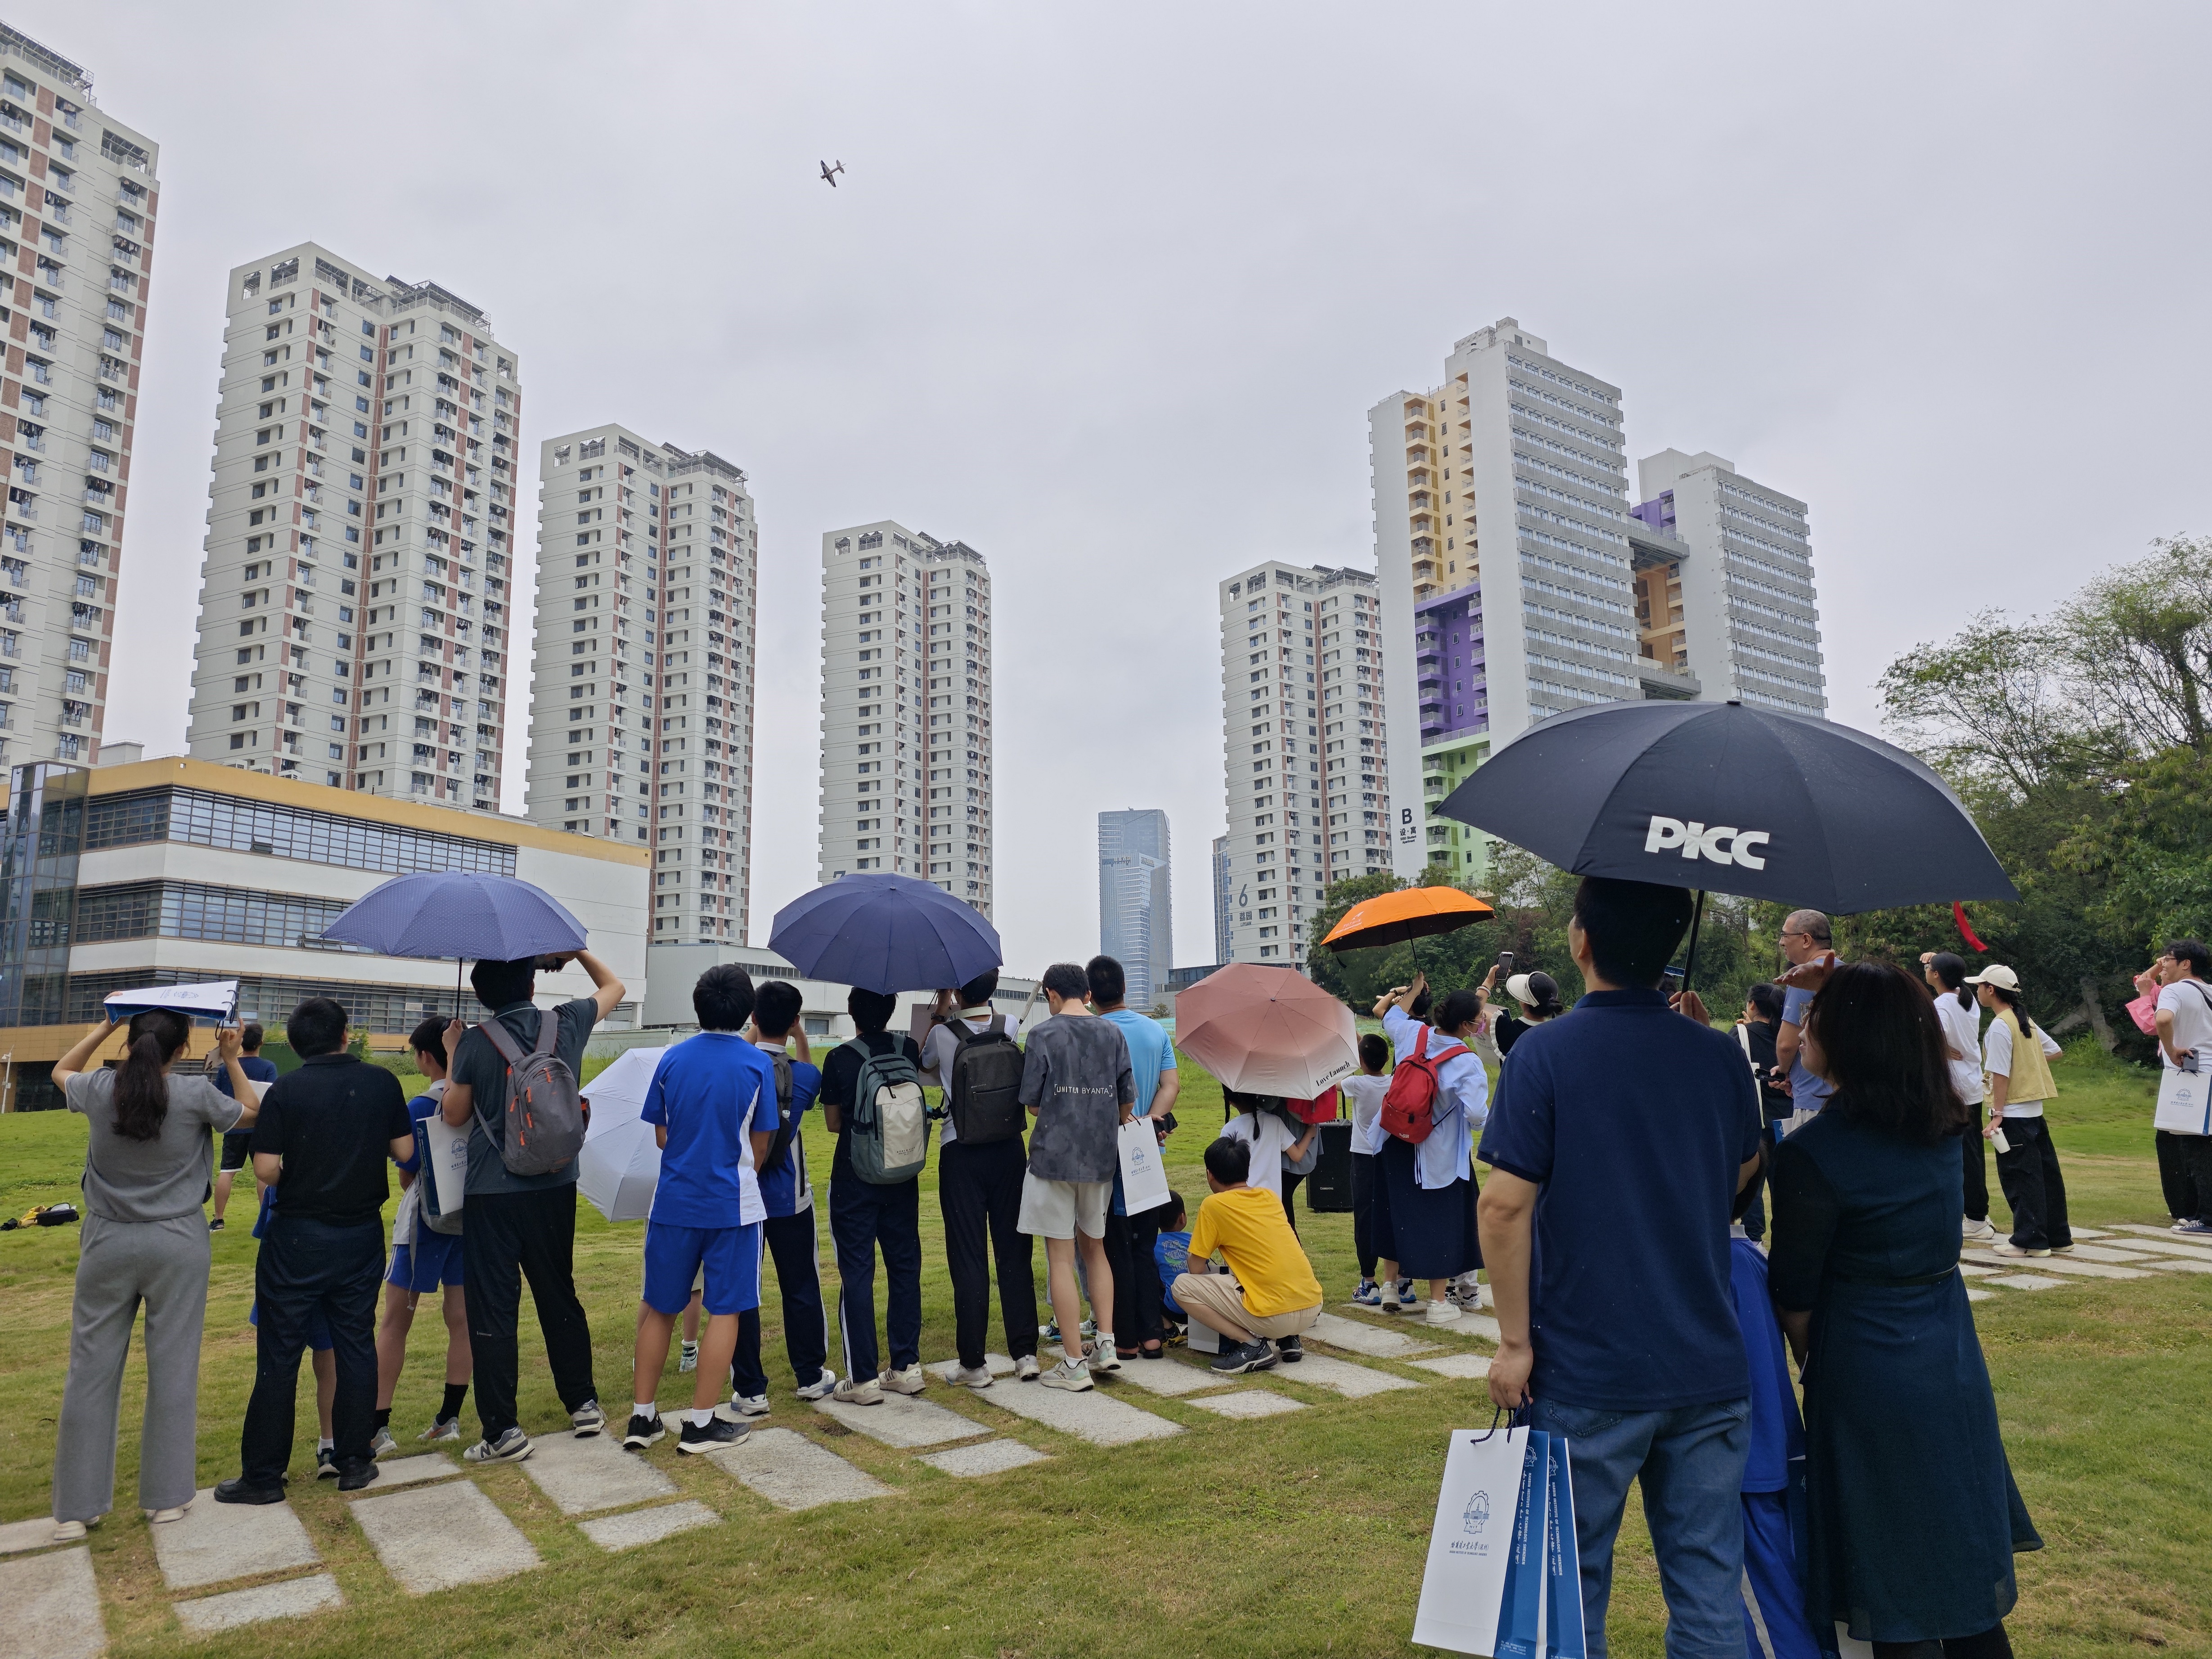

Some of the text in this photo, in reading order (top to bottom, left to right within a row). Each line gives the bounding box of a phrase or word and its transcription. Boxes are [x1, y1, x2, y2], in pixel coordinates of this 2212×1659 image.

[1402, 808, 1412, 824] B
[1644, 815, 1770, 870] PICC
[1239, 884, 1248, 907] 6
[1239, 911, 1252, 922] 荔园
[1316, 1061, 1350, 1087] Love Launch
[1057, 1086, 1079, 1094] UNITA
[480, 1443, 492, 1459] N
